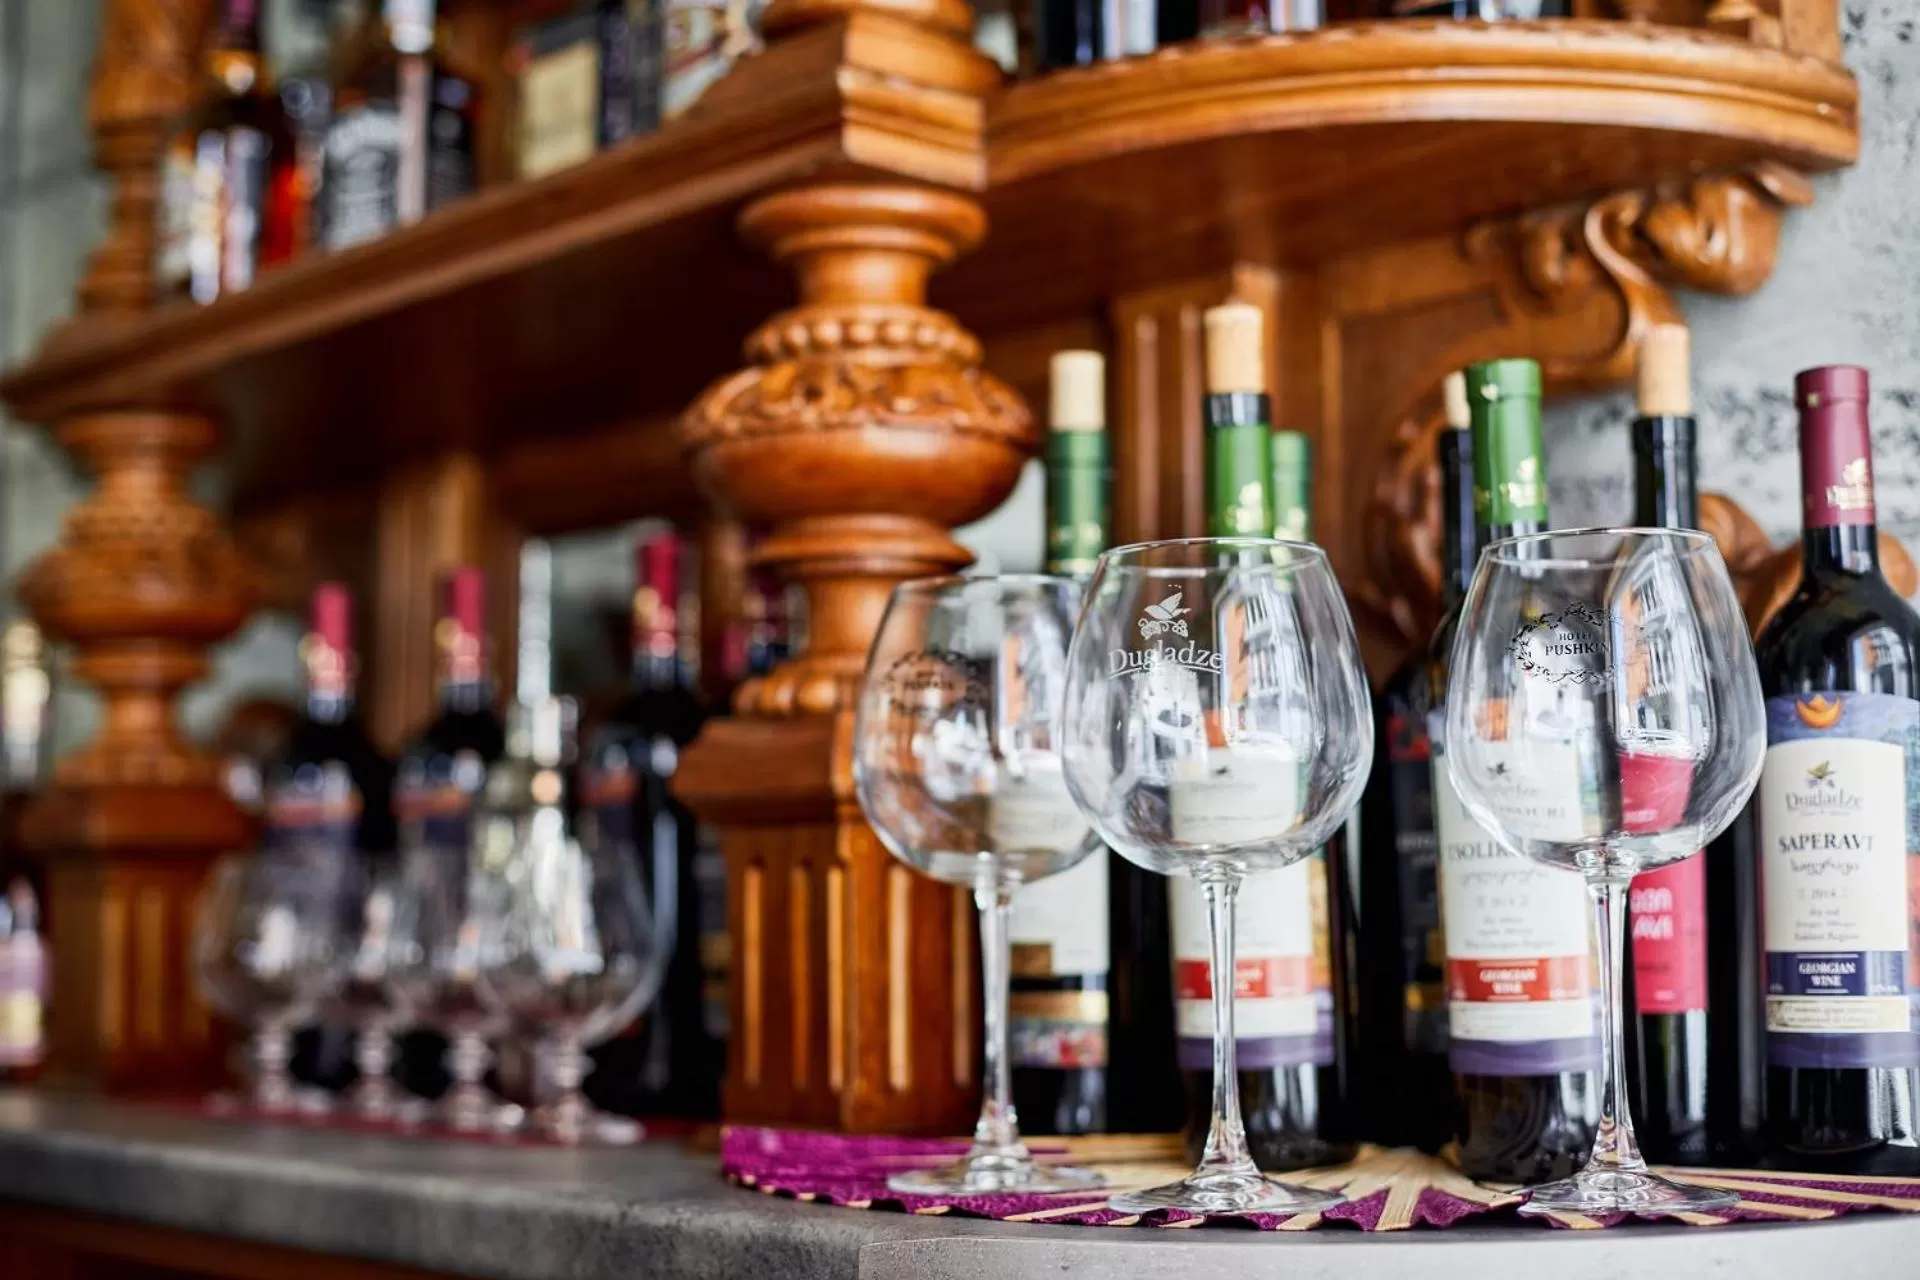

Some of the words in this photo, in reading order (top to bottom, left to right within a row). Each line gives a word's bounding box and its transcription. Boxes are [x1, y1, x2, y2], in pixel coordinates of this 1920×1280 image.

[1559, 632, 1592, 641] HOTEL
[1545, 642, 1610, 656] PUSHKIN
[1107, 640, 1224, 673] Dugladze
[1798, 962, 1857, 974] GEORGIAN
[1811, 975, 1843, 987] WINE
